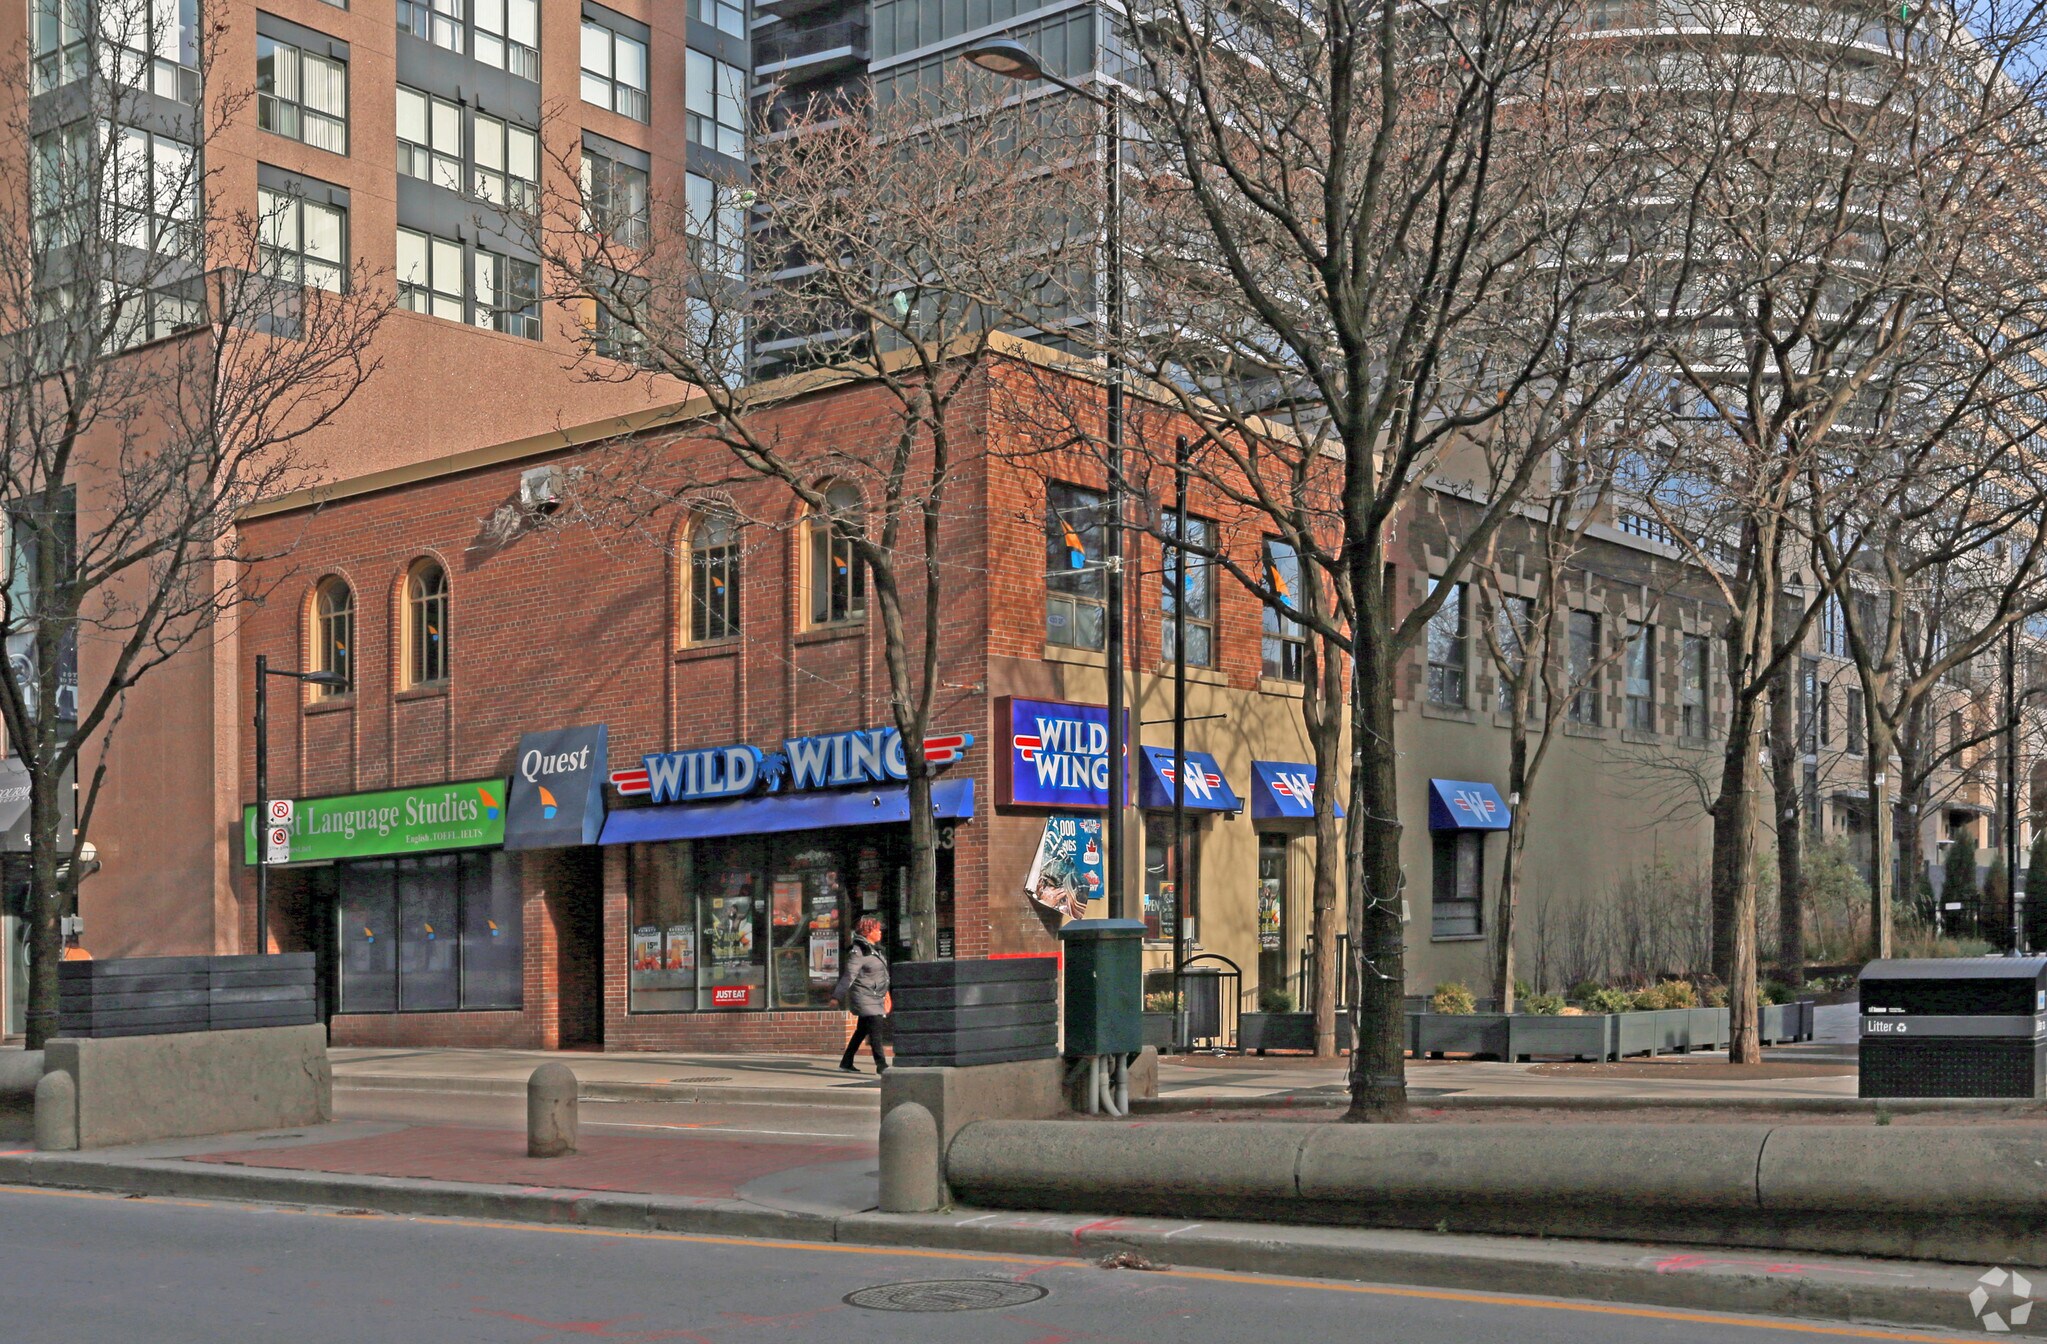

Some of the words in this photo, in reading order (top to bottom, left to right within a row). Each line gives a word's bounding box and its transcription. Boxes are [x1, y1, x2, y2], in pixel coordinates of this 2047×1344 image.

[1036, 717, 1108, 755] WILD
[521, 744, 590, 783] Quest
[643, 746, 758, 801] WILD
[1033, 752, 1109, 790] WING
[307, 805, 400, 840] Language
[405, 791, 478, 827] Studies
[1456, 789, 1493, 823] W
[405, 833, 430, 845] English
[715, 990, 732, 999] JUST
[732, 989, 746, 998] EAT
[1868, 1020, 1894, 1032] Litter
